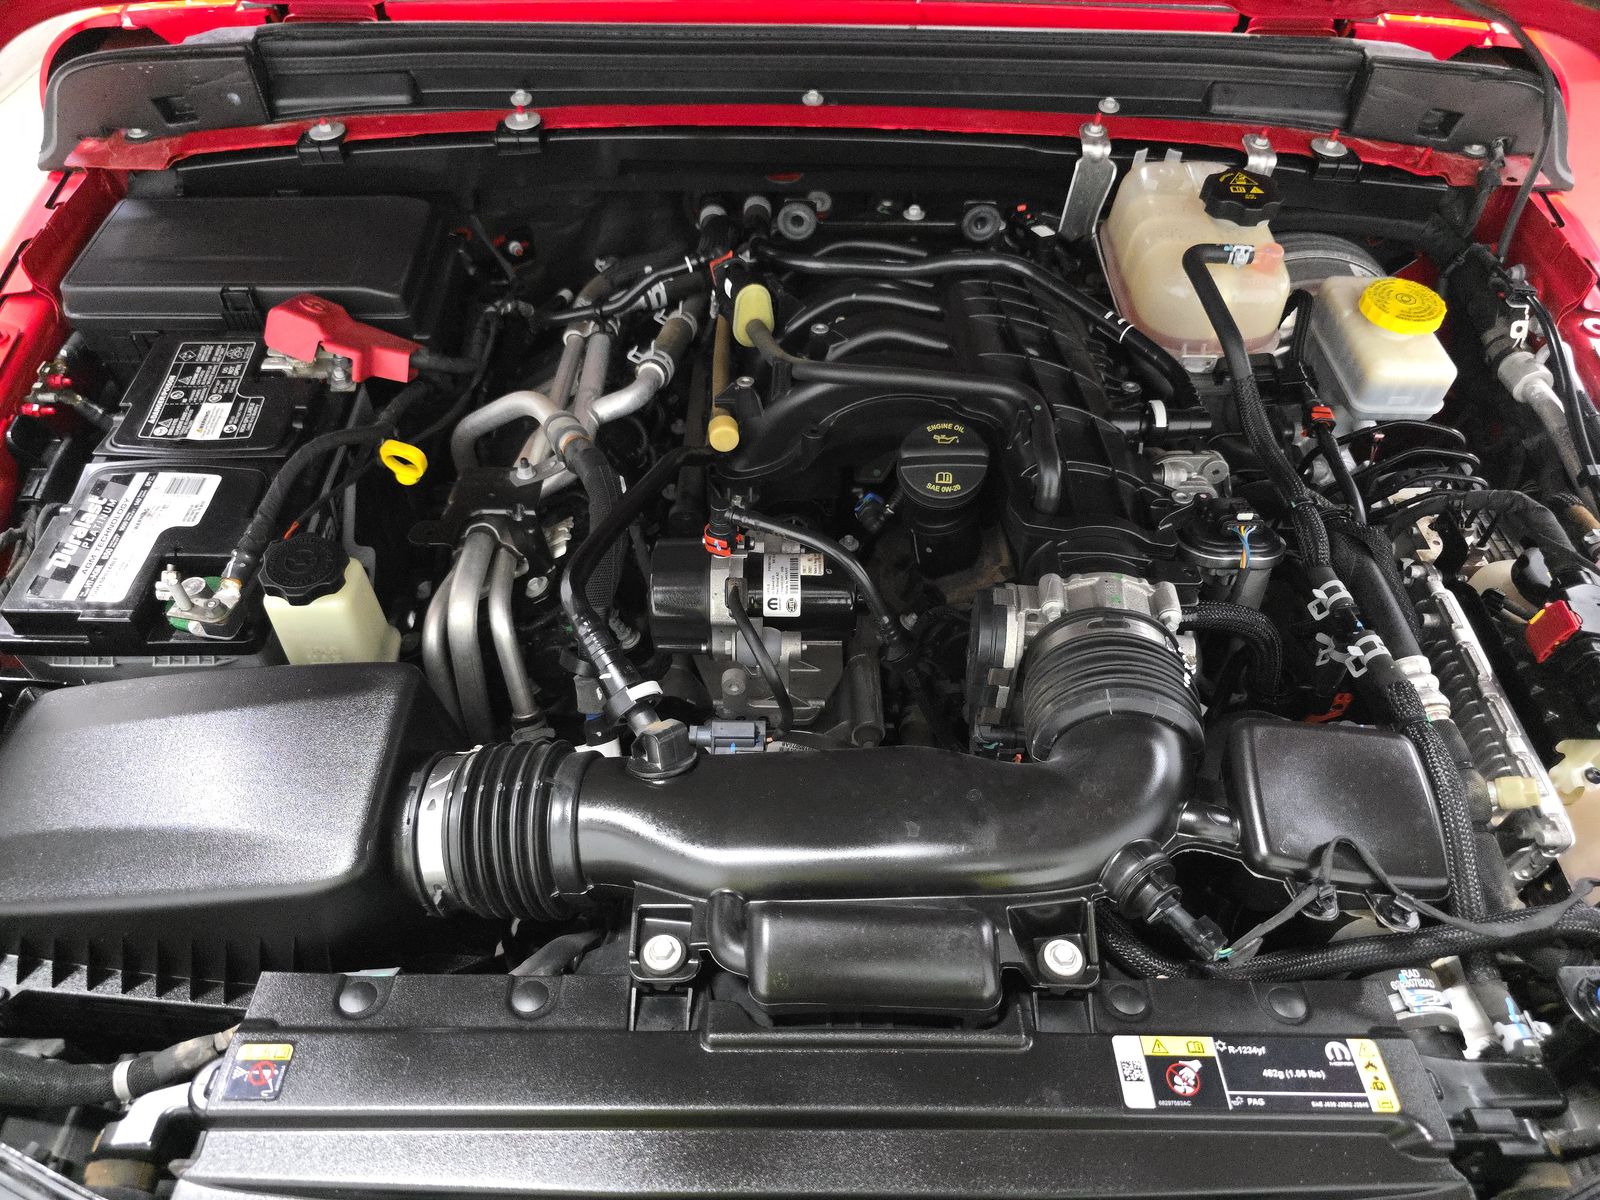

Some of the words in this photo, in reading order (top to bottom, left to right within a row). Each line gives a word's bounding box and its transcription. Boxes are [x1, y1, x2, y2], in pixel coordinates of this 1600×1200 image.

[927, 423, 953, 432] ENGINE
[954, 424, 965, 433] OIL
[926, 482, 940, 492] SAE
[941, 484, 961, 493] 0W-20
[80, 498, 119, 547] PLATINUM
[44, 495, 110, 570] Duralast
[80, 554, 98, 574] AGM
[93, 497, 131, 550] TECHNOLOGY
[1401, 969, 1420, 978] RAD
[1228, 1046, 1266, 1056] R-1234yf
[1247, 1098, 1266, 1106] PAG
